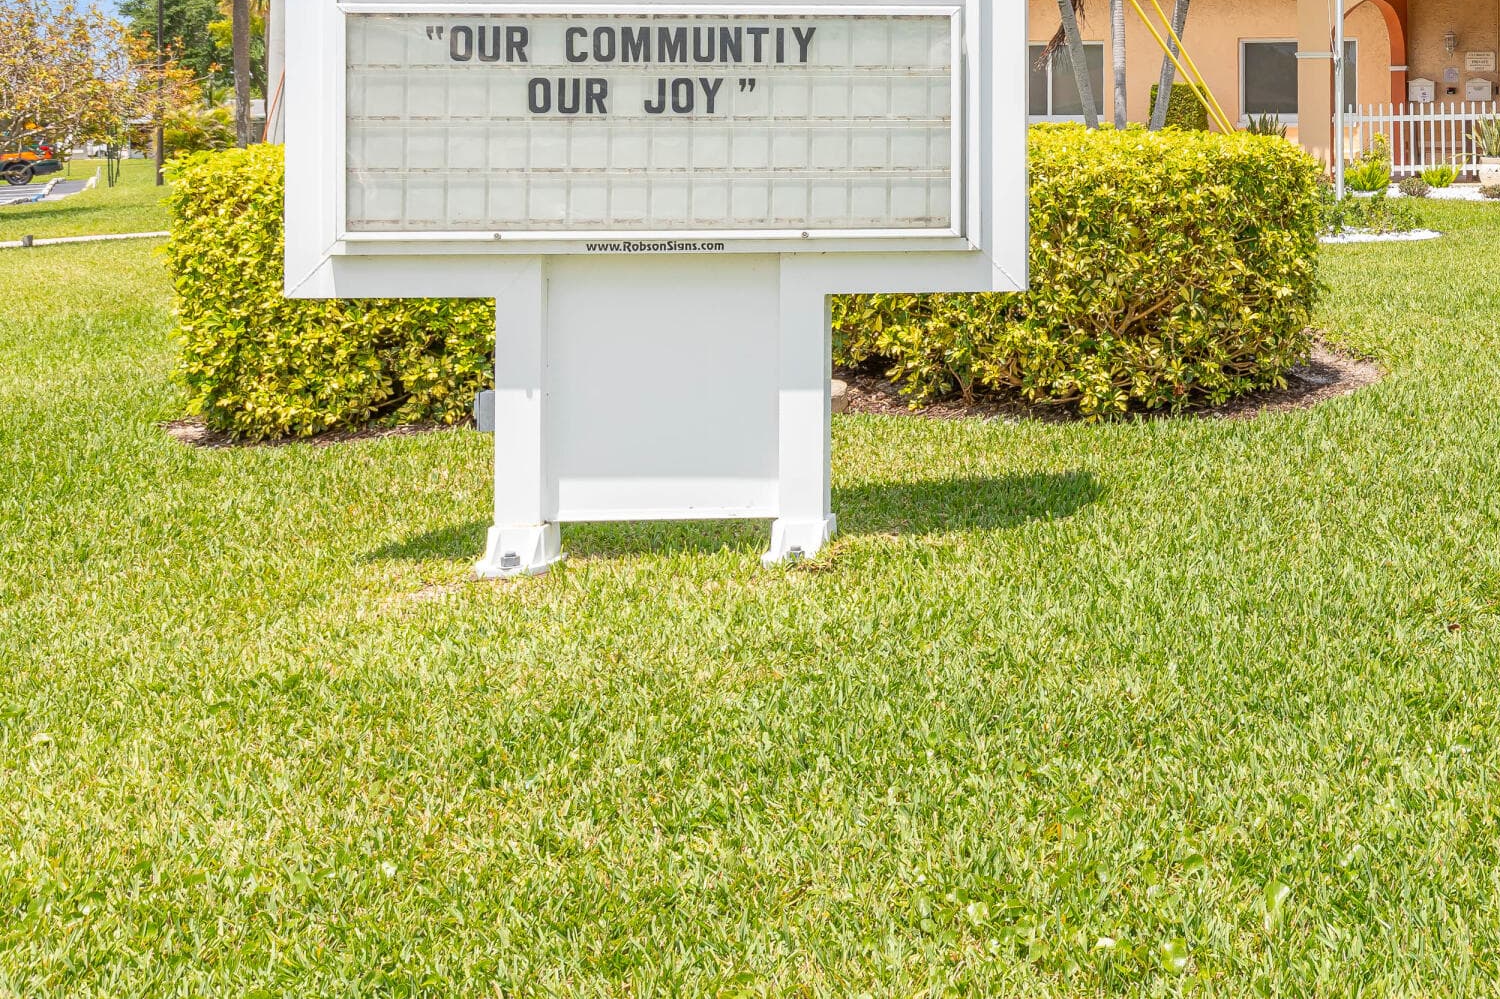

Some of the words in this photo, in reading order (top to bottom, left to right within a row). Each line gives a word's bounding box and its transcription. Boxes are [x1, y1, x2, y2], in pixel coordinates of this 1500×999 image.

[565, 26, 818, 64] COMMUNTIY
[527, 77, 608, 115] OUR
[585, 241, 725, 252] www.RobsonSigns.com
